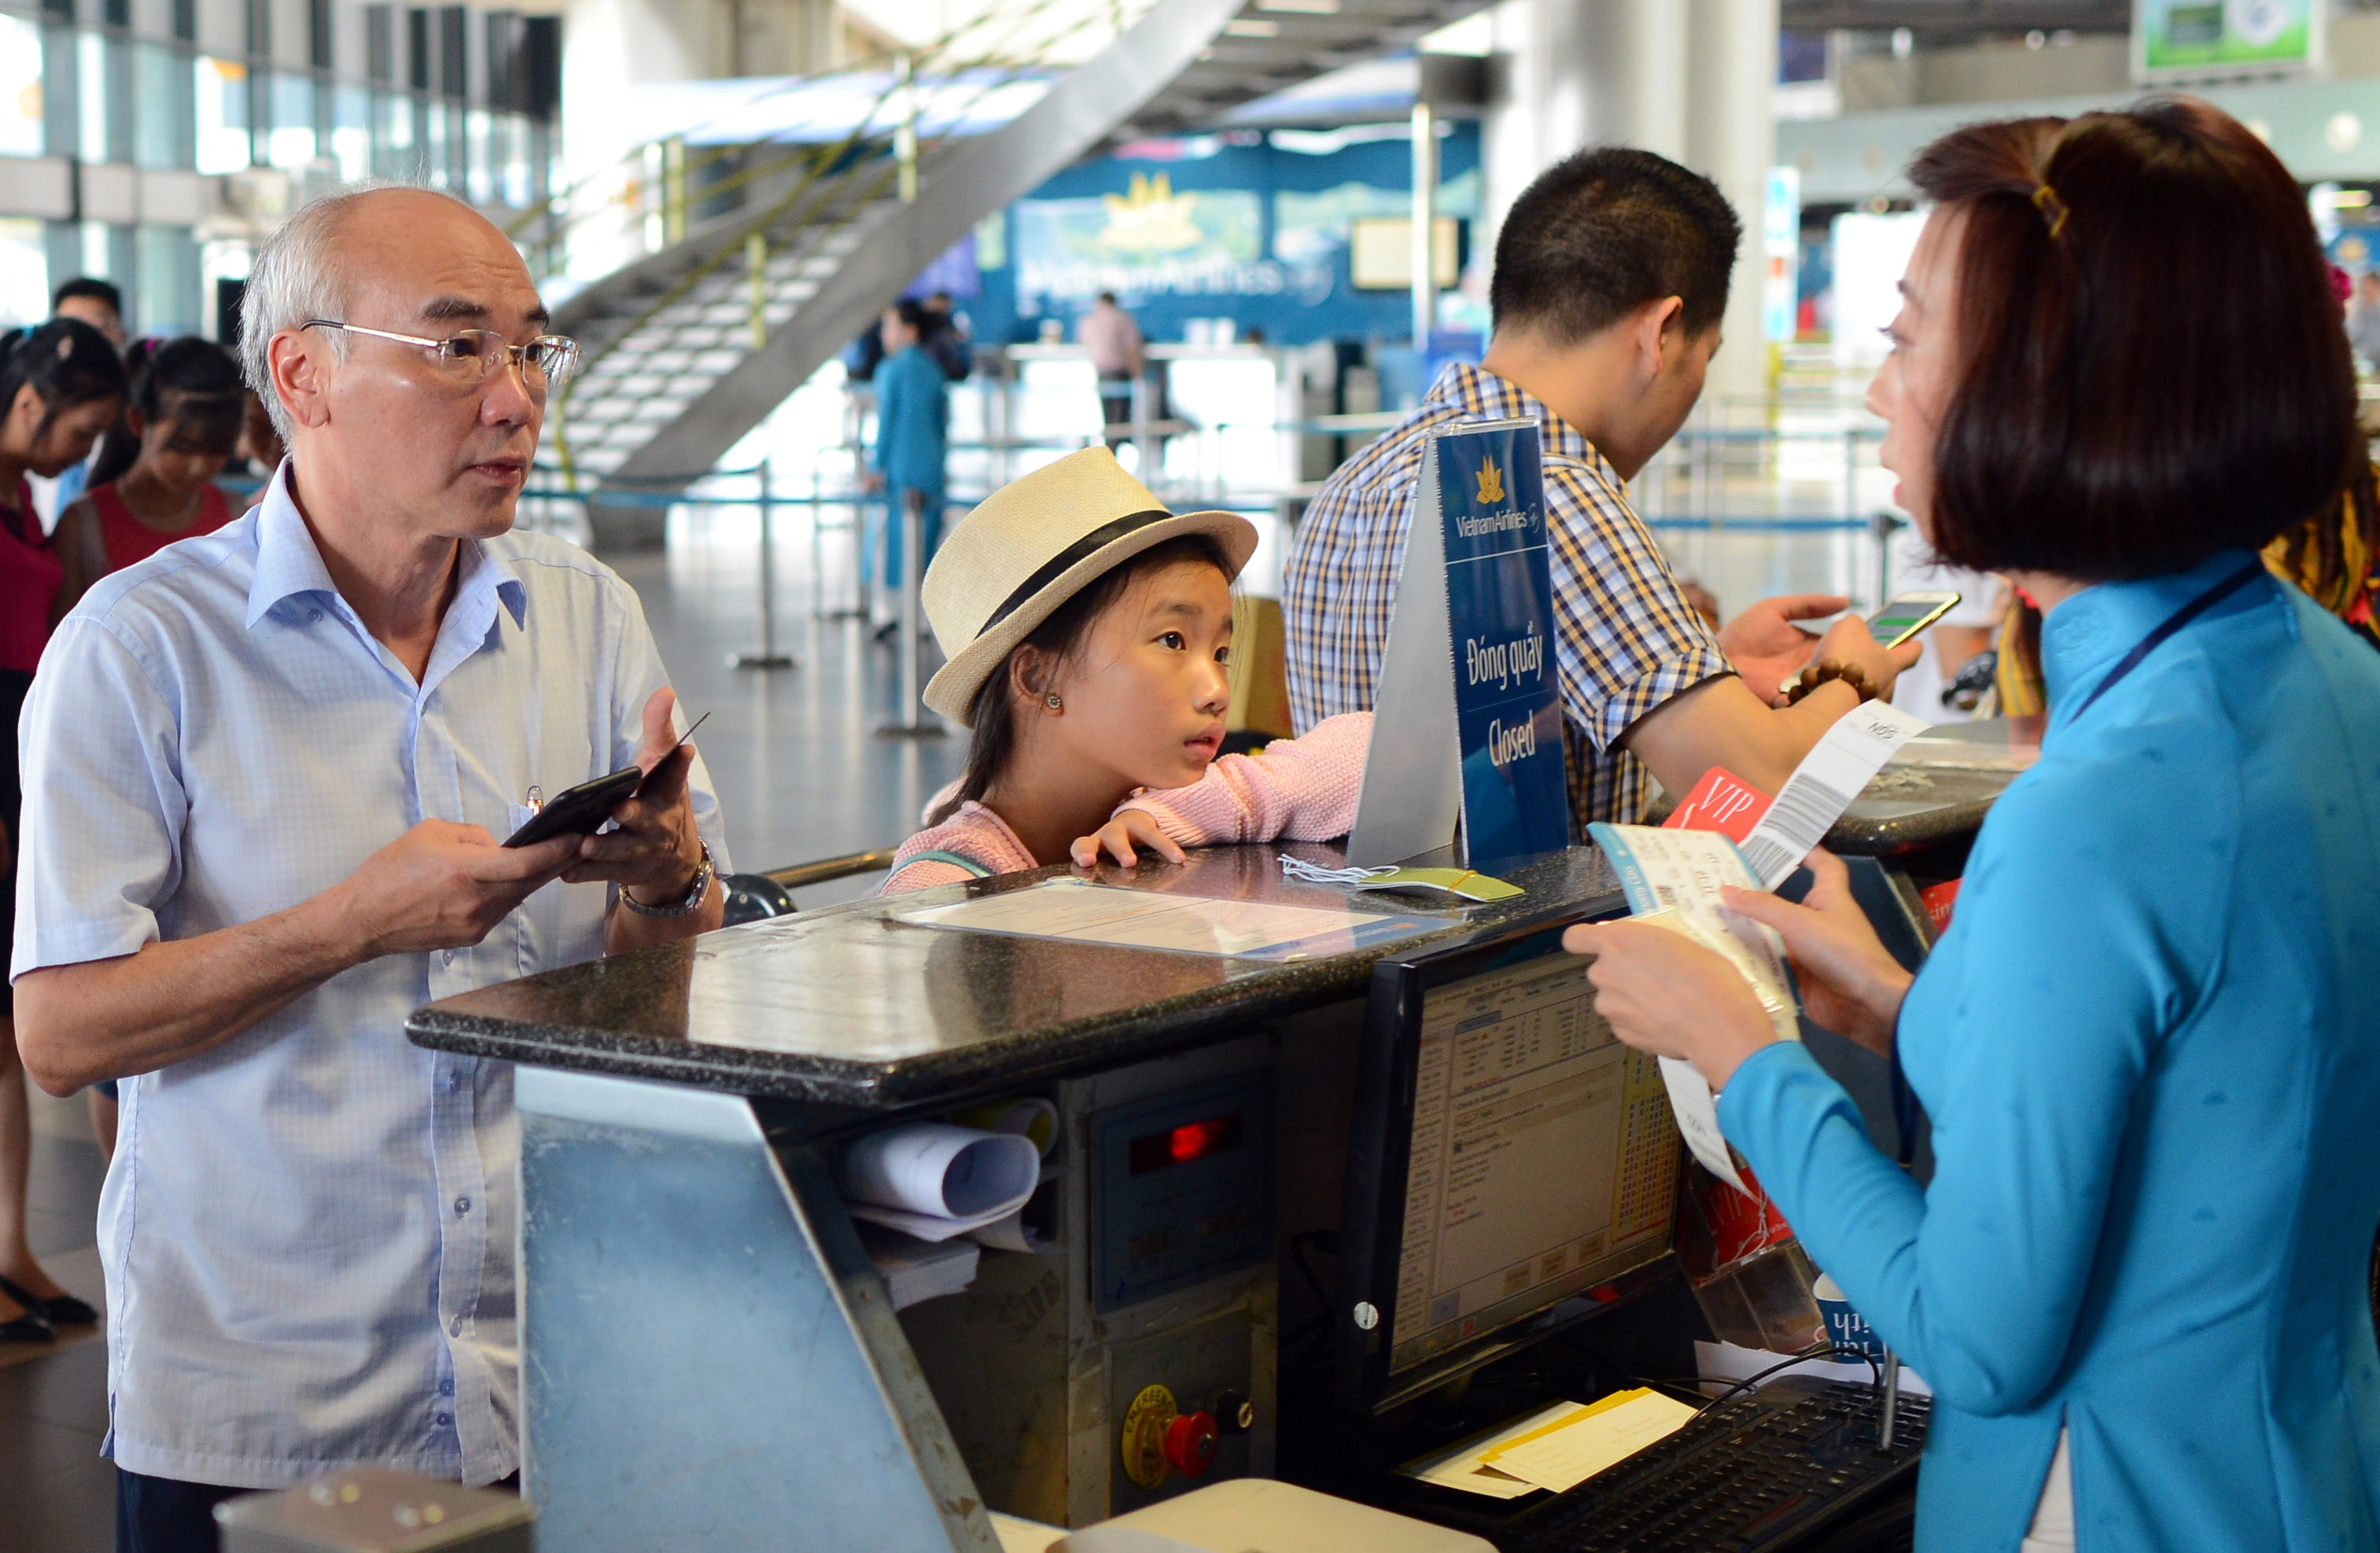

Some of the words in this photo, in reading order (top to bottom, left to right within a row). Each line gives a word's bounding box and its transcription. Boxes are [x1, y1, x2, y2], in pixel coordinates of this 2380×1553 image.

[1456, 509, 1527, 538] VietnamAirlines
[1467, 635, 1508, 691] Đóng
[1488, 709, 1535, 767] Closed
[1700, 775, 1755, 824] VIP
